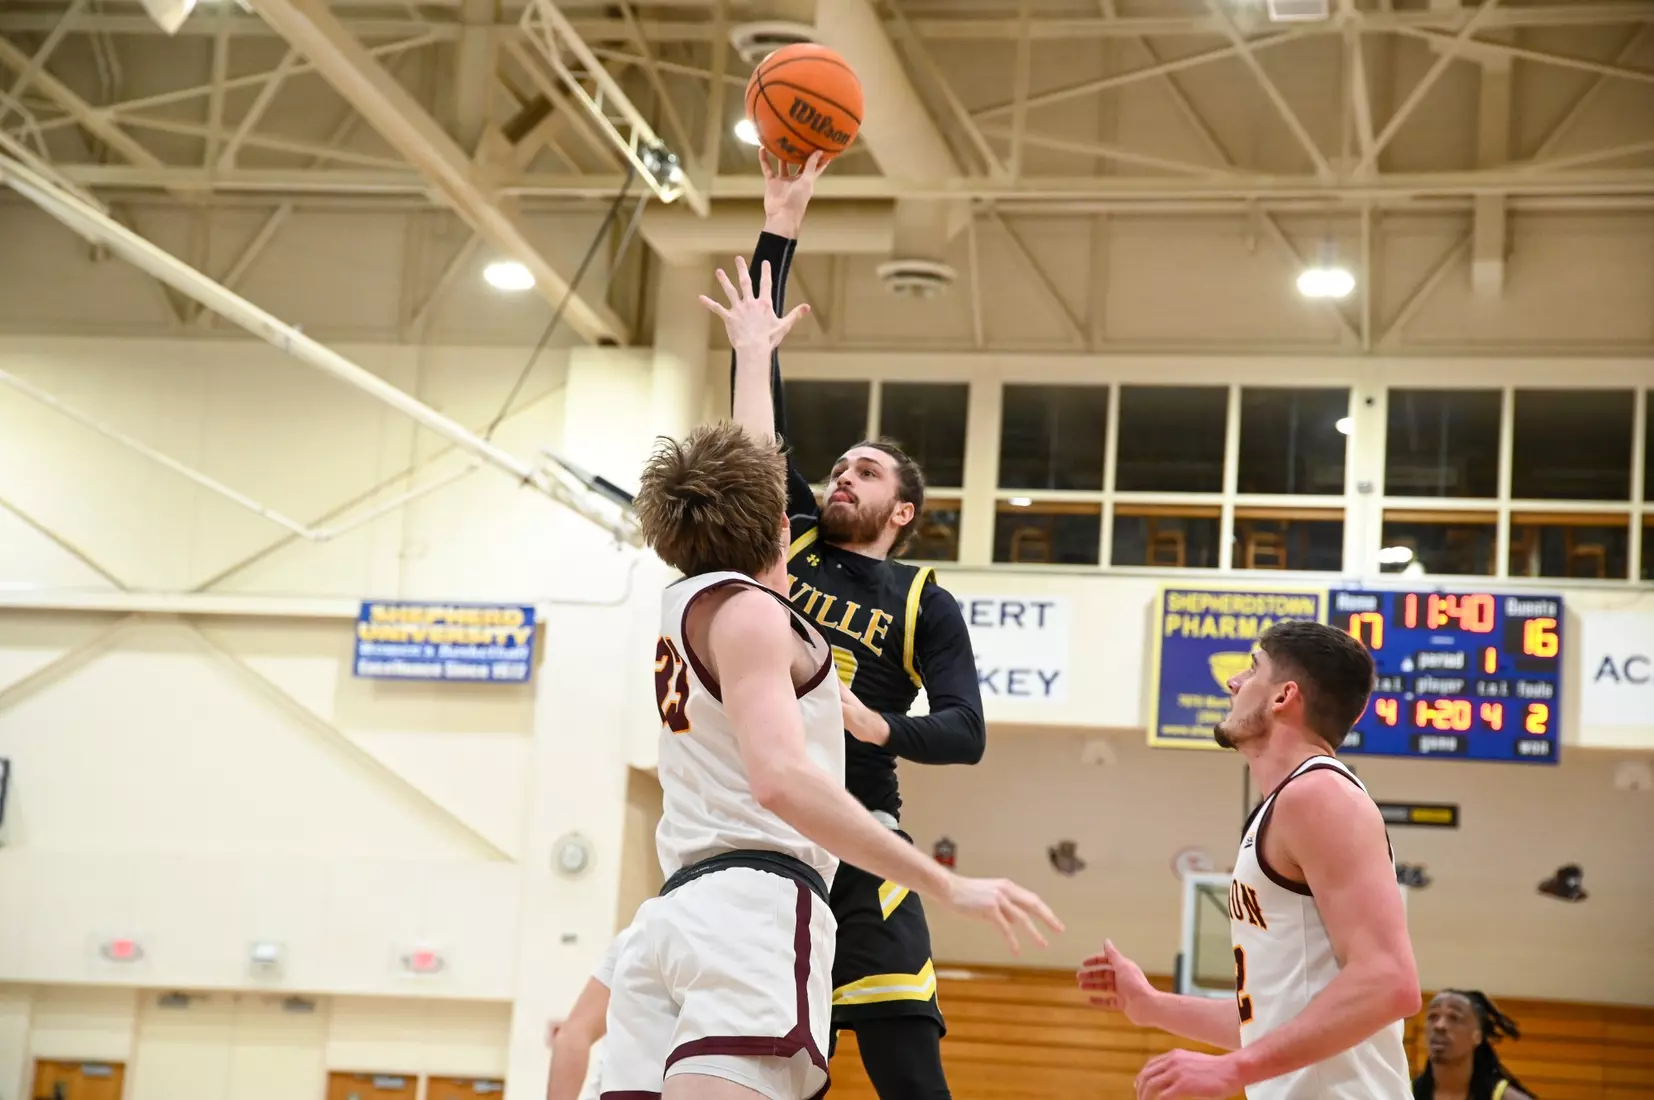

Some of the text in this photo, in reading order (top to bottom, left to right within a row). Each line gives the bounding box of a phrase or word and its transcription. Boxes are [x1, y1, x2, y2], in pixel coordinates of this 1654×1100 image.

[789, 96, 852, 146] Wilson
[371, 605, 525, 626] SHEPHERD
[957, 599, 1055, 629] ERT
[1167, 592, 1317, 616] SHEPHERDSTOWN
[1336, 593, 1377, 611] Home
[1404, 593, 1495, 633] 11:40
[358, 624, 532, 645] UNIVERSITY
[1349, 612, 1384, 650] 17
[1523, 617, 1559, 658] 16
[1484, 646, 1497, 674] 1
[1375, 698, 1398, 727] 4
[1480, 702, 1503, 731] 4
[1526, 703, 1549, 735] 2
